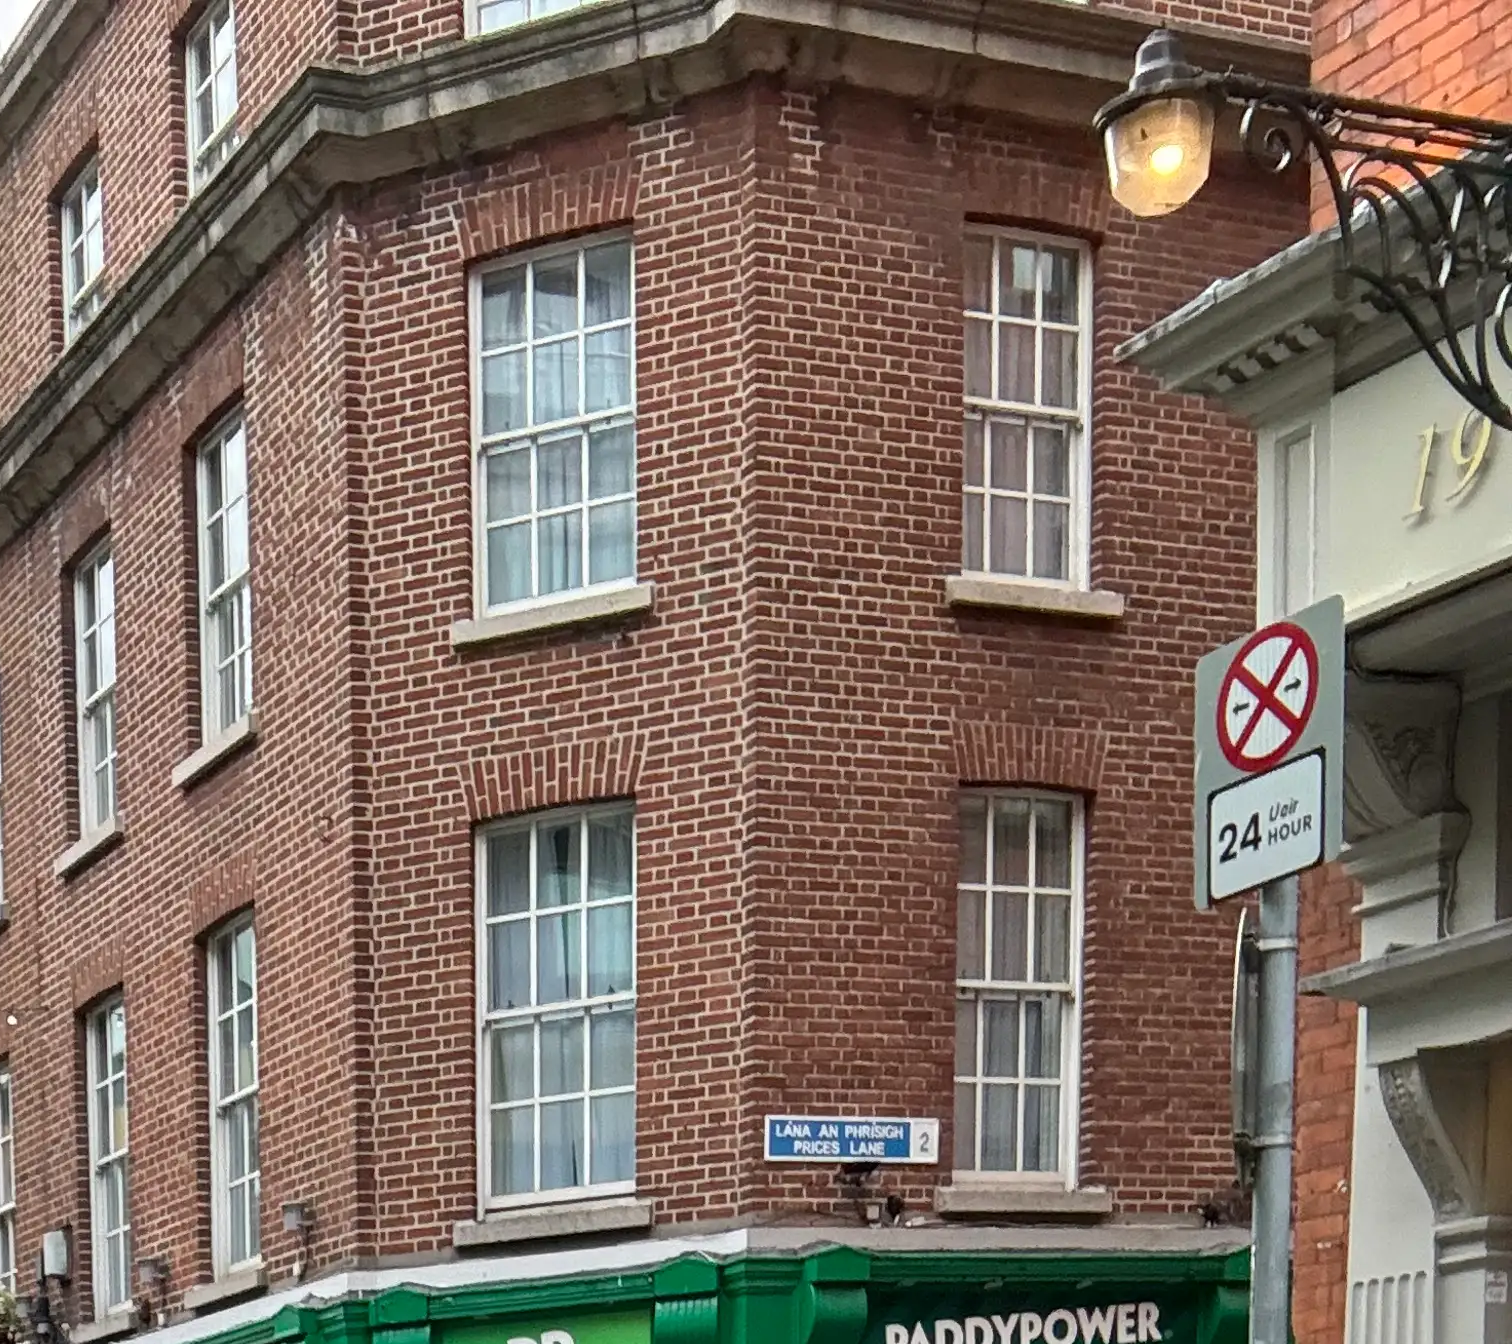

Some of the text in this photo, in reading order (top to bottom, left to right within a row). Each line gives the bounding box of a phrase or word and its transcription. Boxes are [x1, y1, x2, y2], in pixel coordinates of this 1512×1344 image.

[1219, 798, 1299, 864] 24 Uair
[1268, 814, 1312, 846] HOUR
[775, 1121, 811, 1138] LÁNA
[819, 1125, 838, 1138] AN
[794, 1141, 885, 1156] PRICES LANE
[919, 1132, 930, 1152] 2
